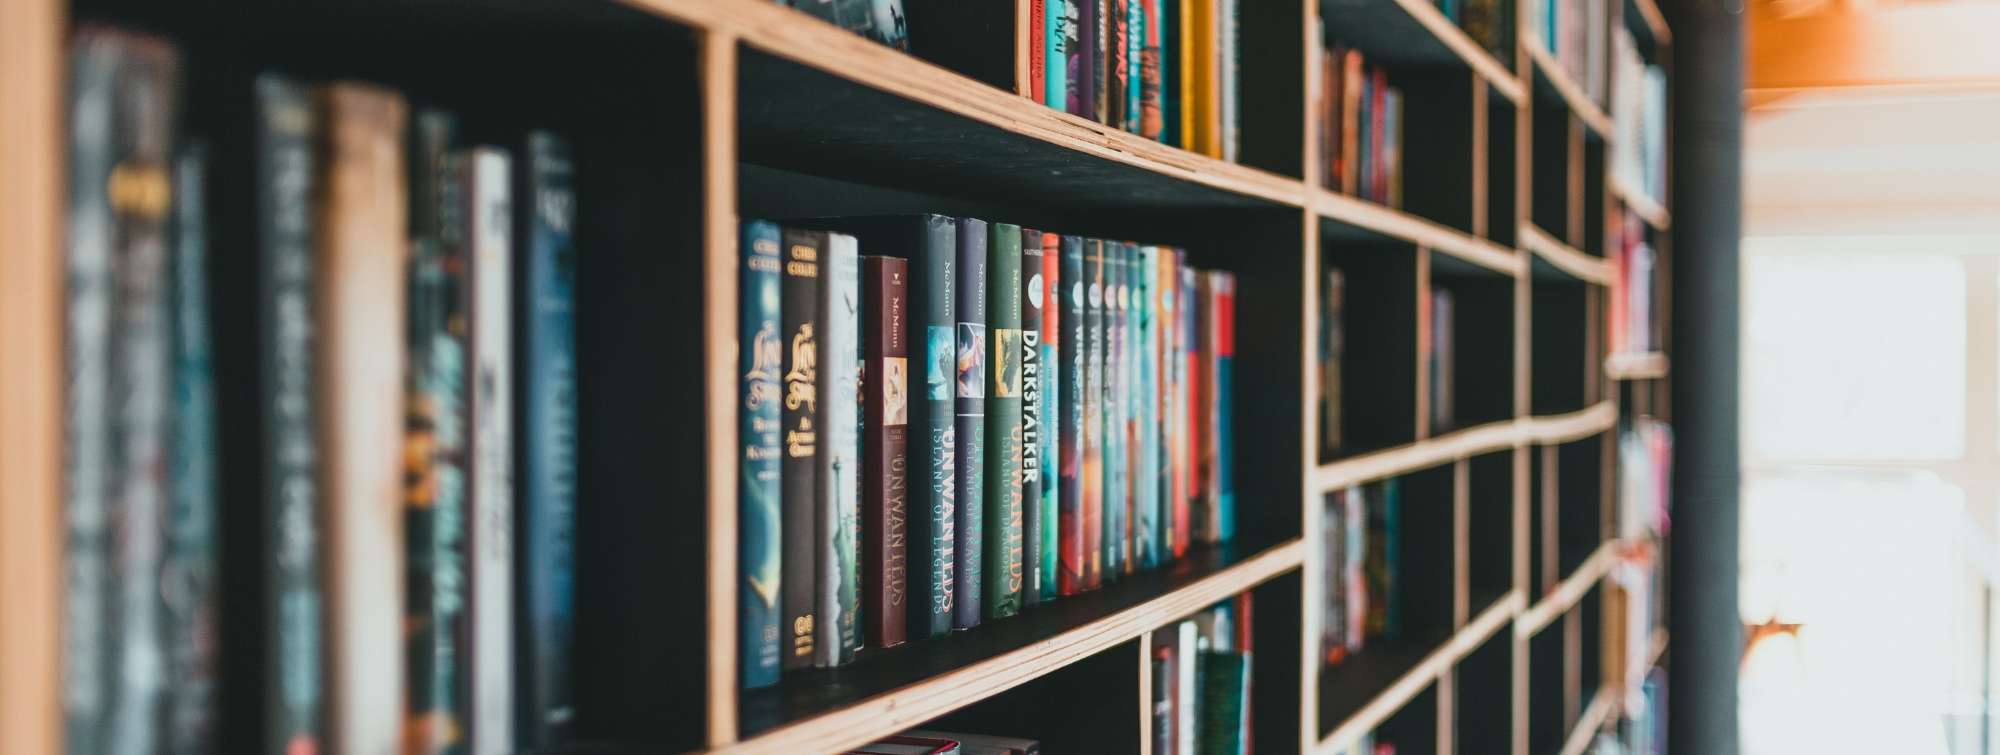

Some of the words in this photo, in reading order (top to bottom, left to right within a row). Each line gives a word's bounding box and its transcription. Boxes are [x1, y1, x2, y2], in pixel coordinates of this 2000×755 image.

[1022, 330, 1039, 484] DARKSTALKER
[934, 428, 942, 494] ISLAND
[966, 442, 974, 495] ISLAND
[1002, 436, 1010, 487] ISLAND
[892, 458, 906, 606] UNWANTEDS
[934, 504, 942, 525] OF
[942, 430, 954, 612] UNWANTEDS
[966, 502, 974, 519] OF
[973, 426, 984, 600] UNWANTEDS
[1002, 494, 1010, 510] OF
[1010, 425, 1023, 594] UNWANTEDS
[886, 534, 892, 549] OF
[965, 526, 974, 583] GRAVES
[1002, 518, 1010, 582] DRAGONS
[934, 536, 942, 614] LEGENDS
